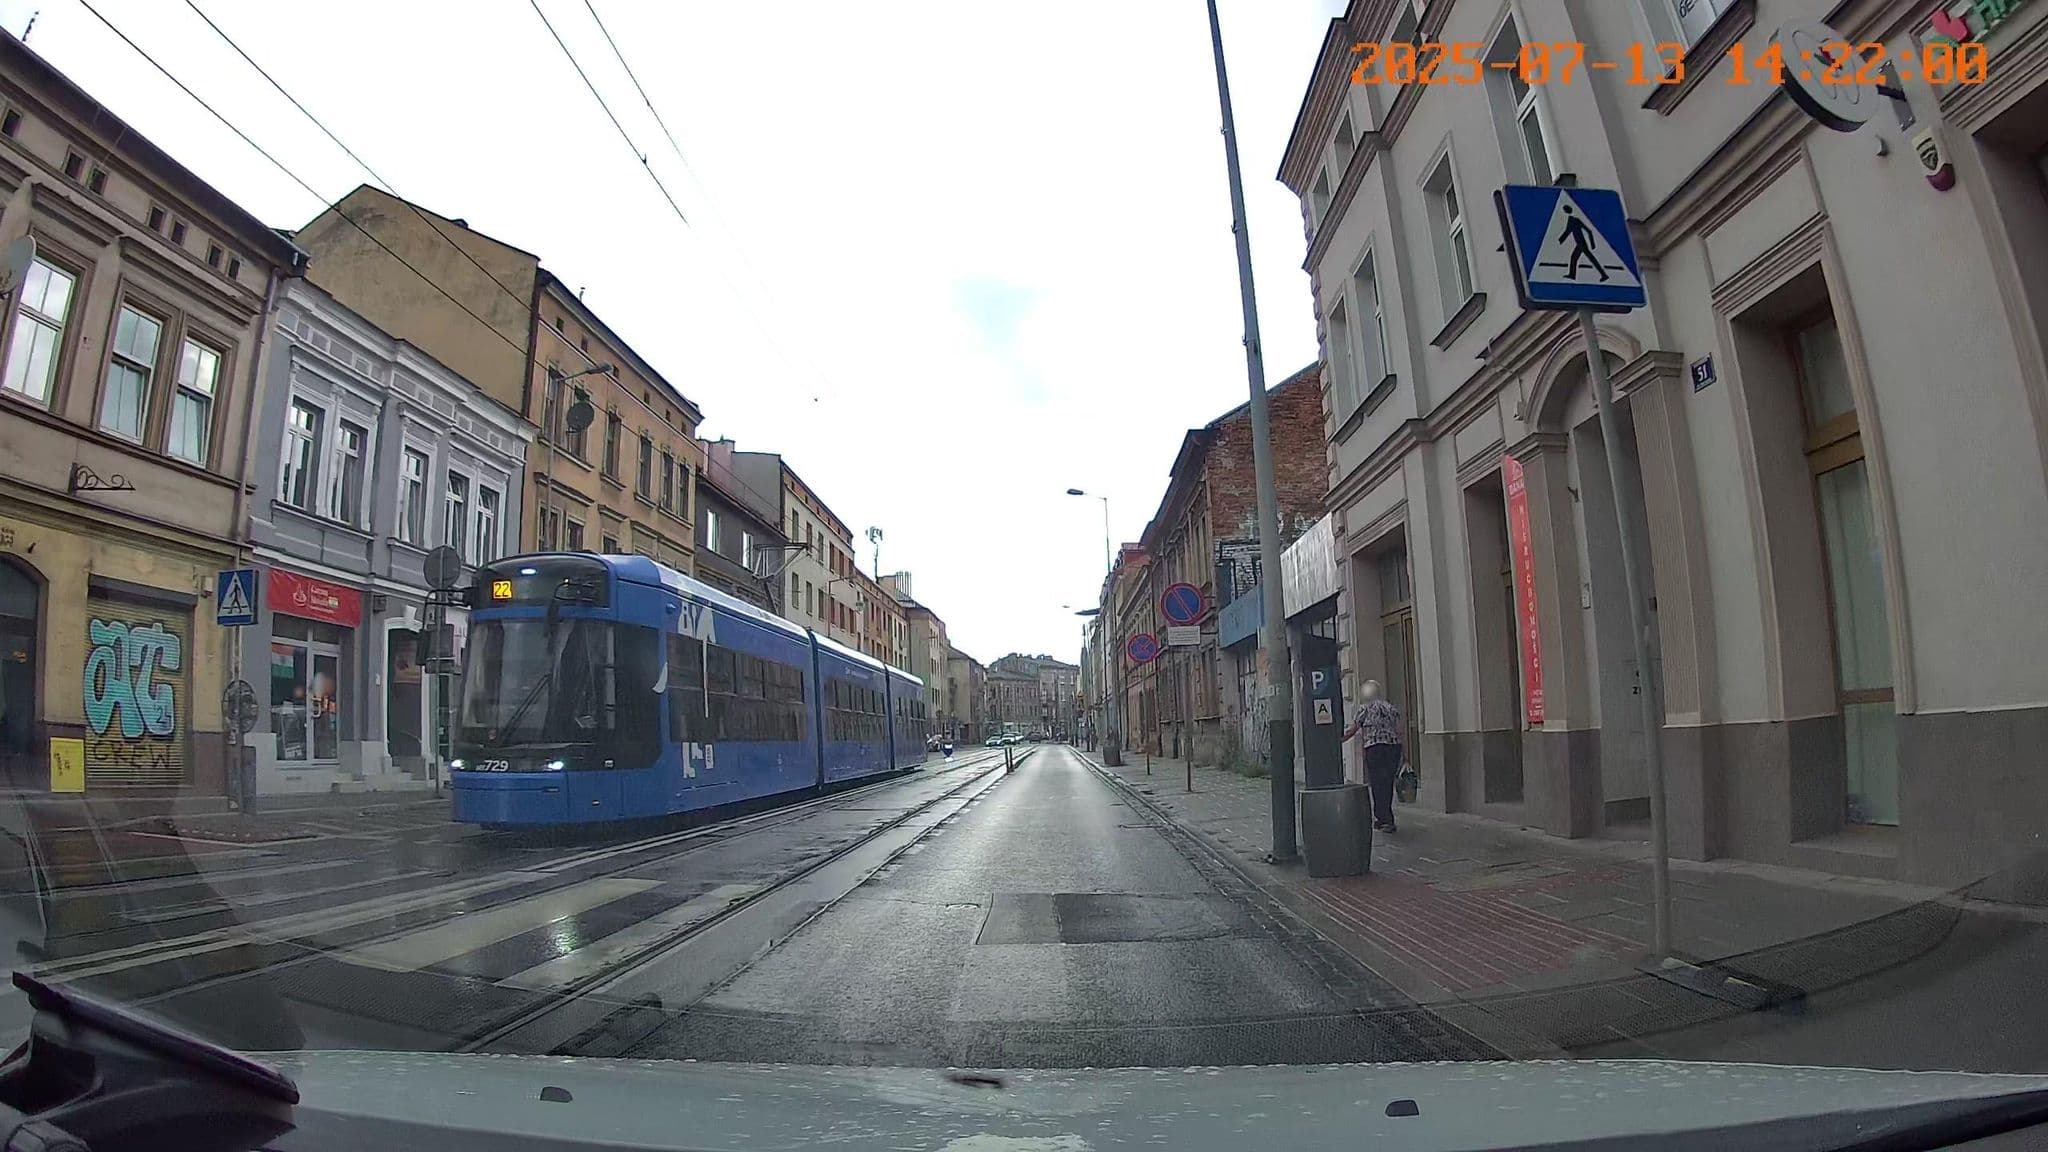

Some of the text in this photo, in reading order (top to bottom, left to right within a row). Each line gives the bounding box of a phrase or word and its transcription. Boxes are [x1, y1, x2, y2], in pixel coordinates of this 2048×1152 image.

[1697, 364, 1708, 382] 51
[493, 581, 512, 599] 22
[1311, 670, 1325, 690] P
[1318, 703, 1329, 715] A
[93, 741, 172, 769] CREW
